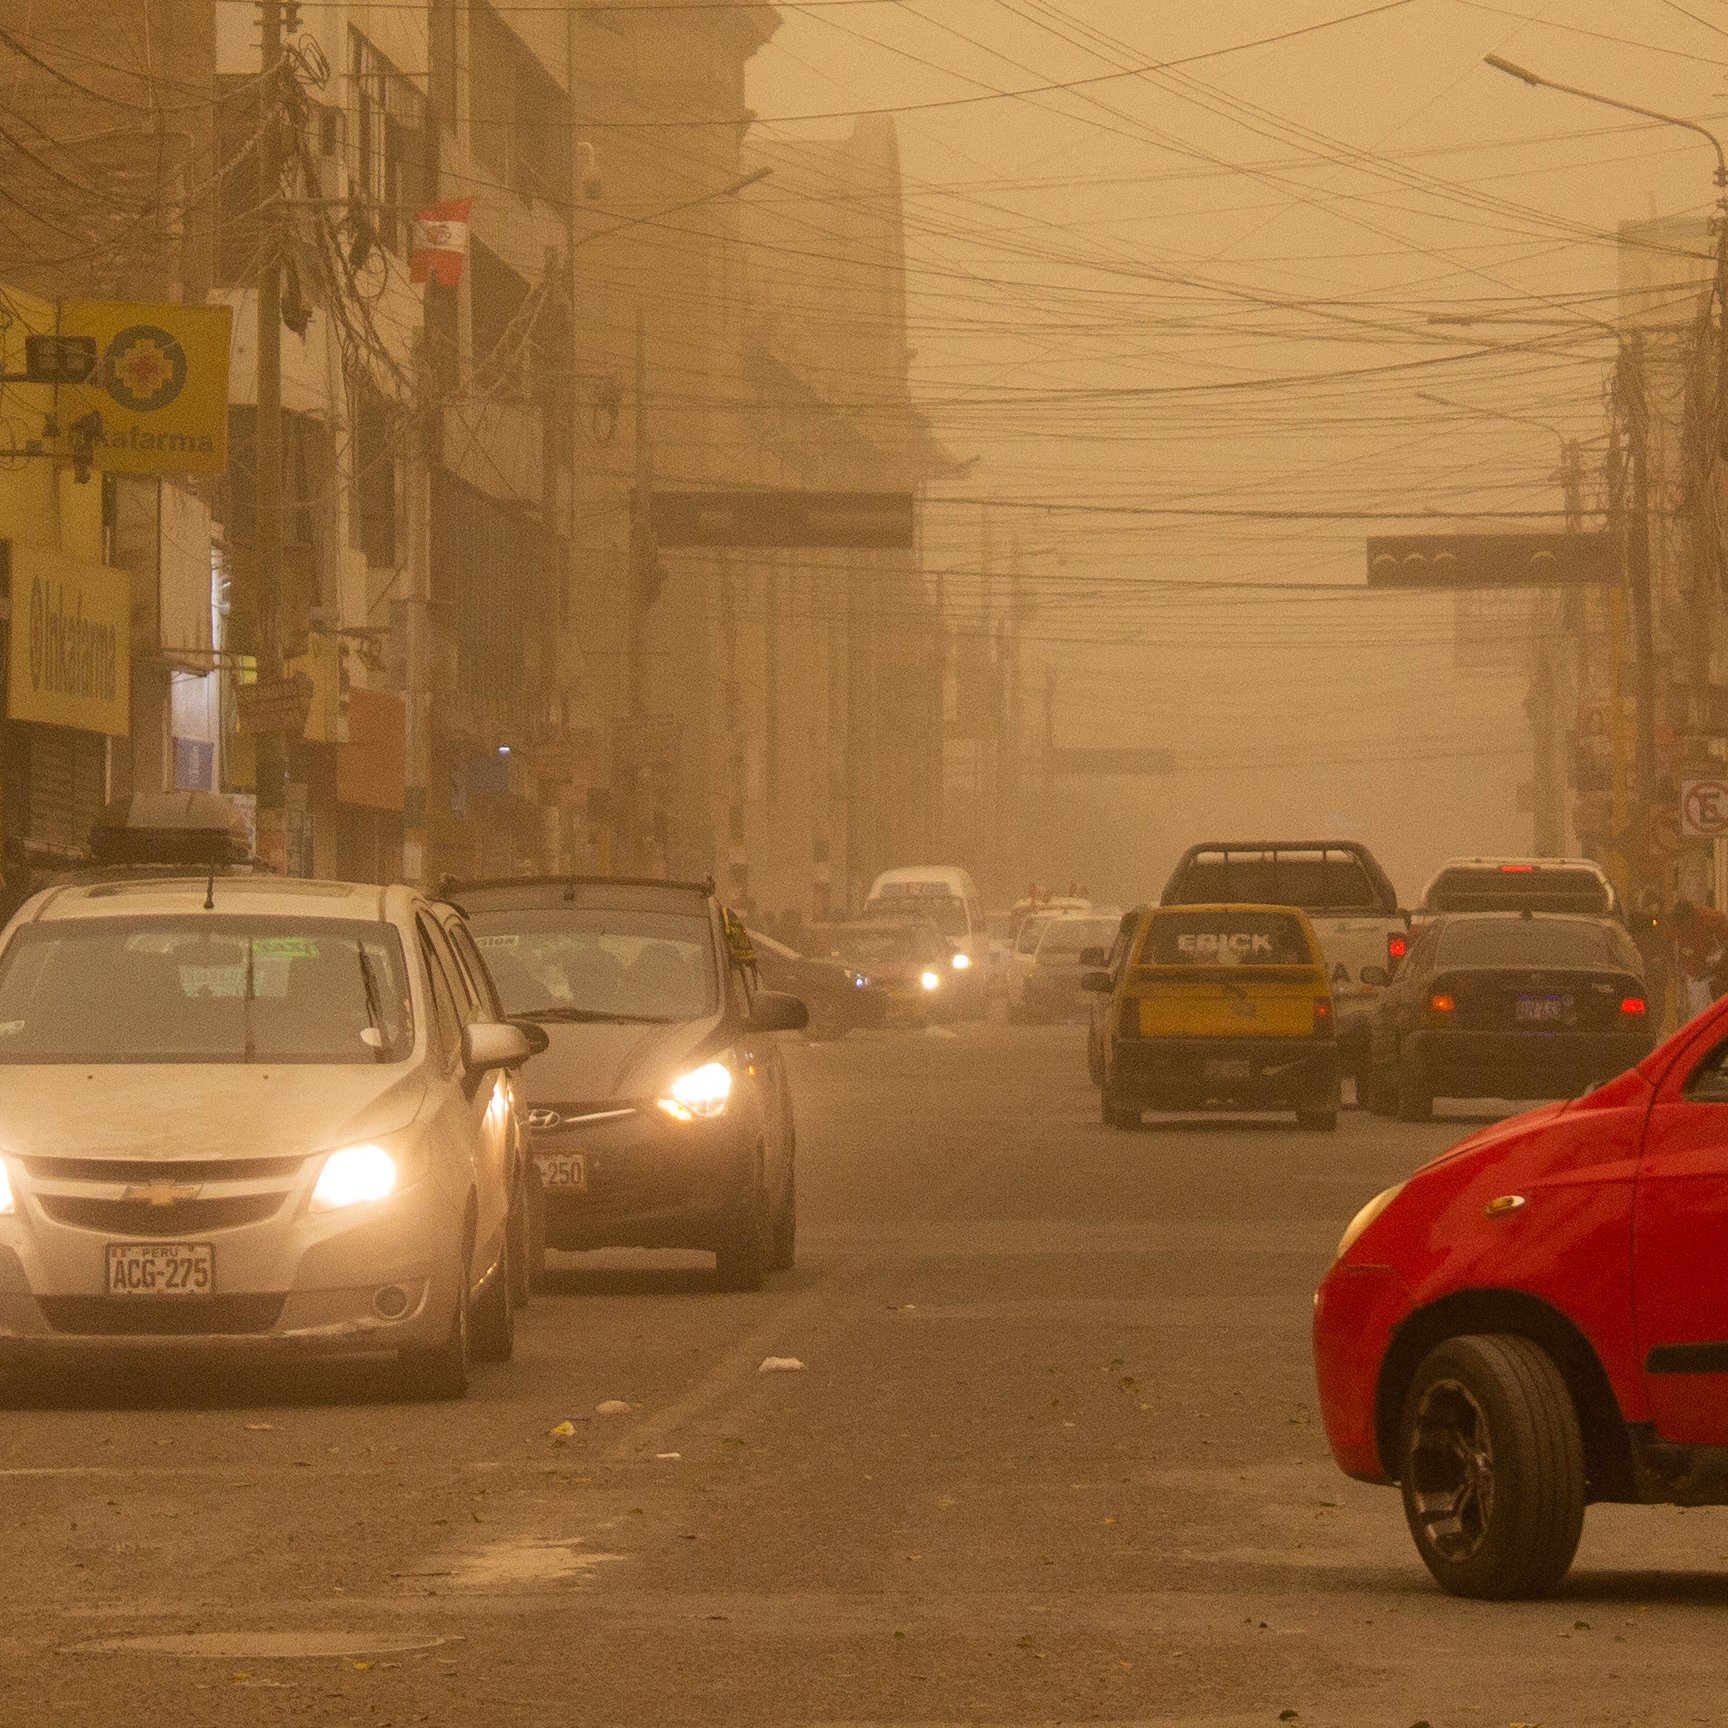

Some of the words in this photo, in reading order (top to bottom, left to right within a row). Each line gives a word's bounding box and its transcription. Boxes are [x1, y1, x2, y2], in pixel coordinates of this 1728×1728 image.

[1176, 932, 1273, 952] ERICK
[142, 1246, 179, 1258] PERU
[113, 1258, 209, 1289] ACG-275
